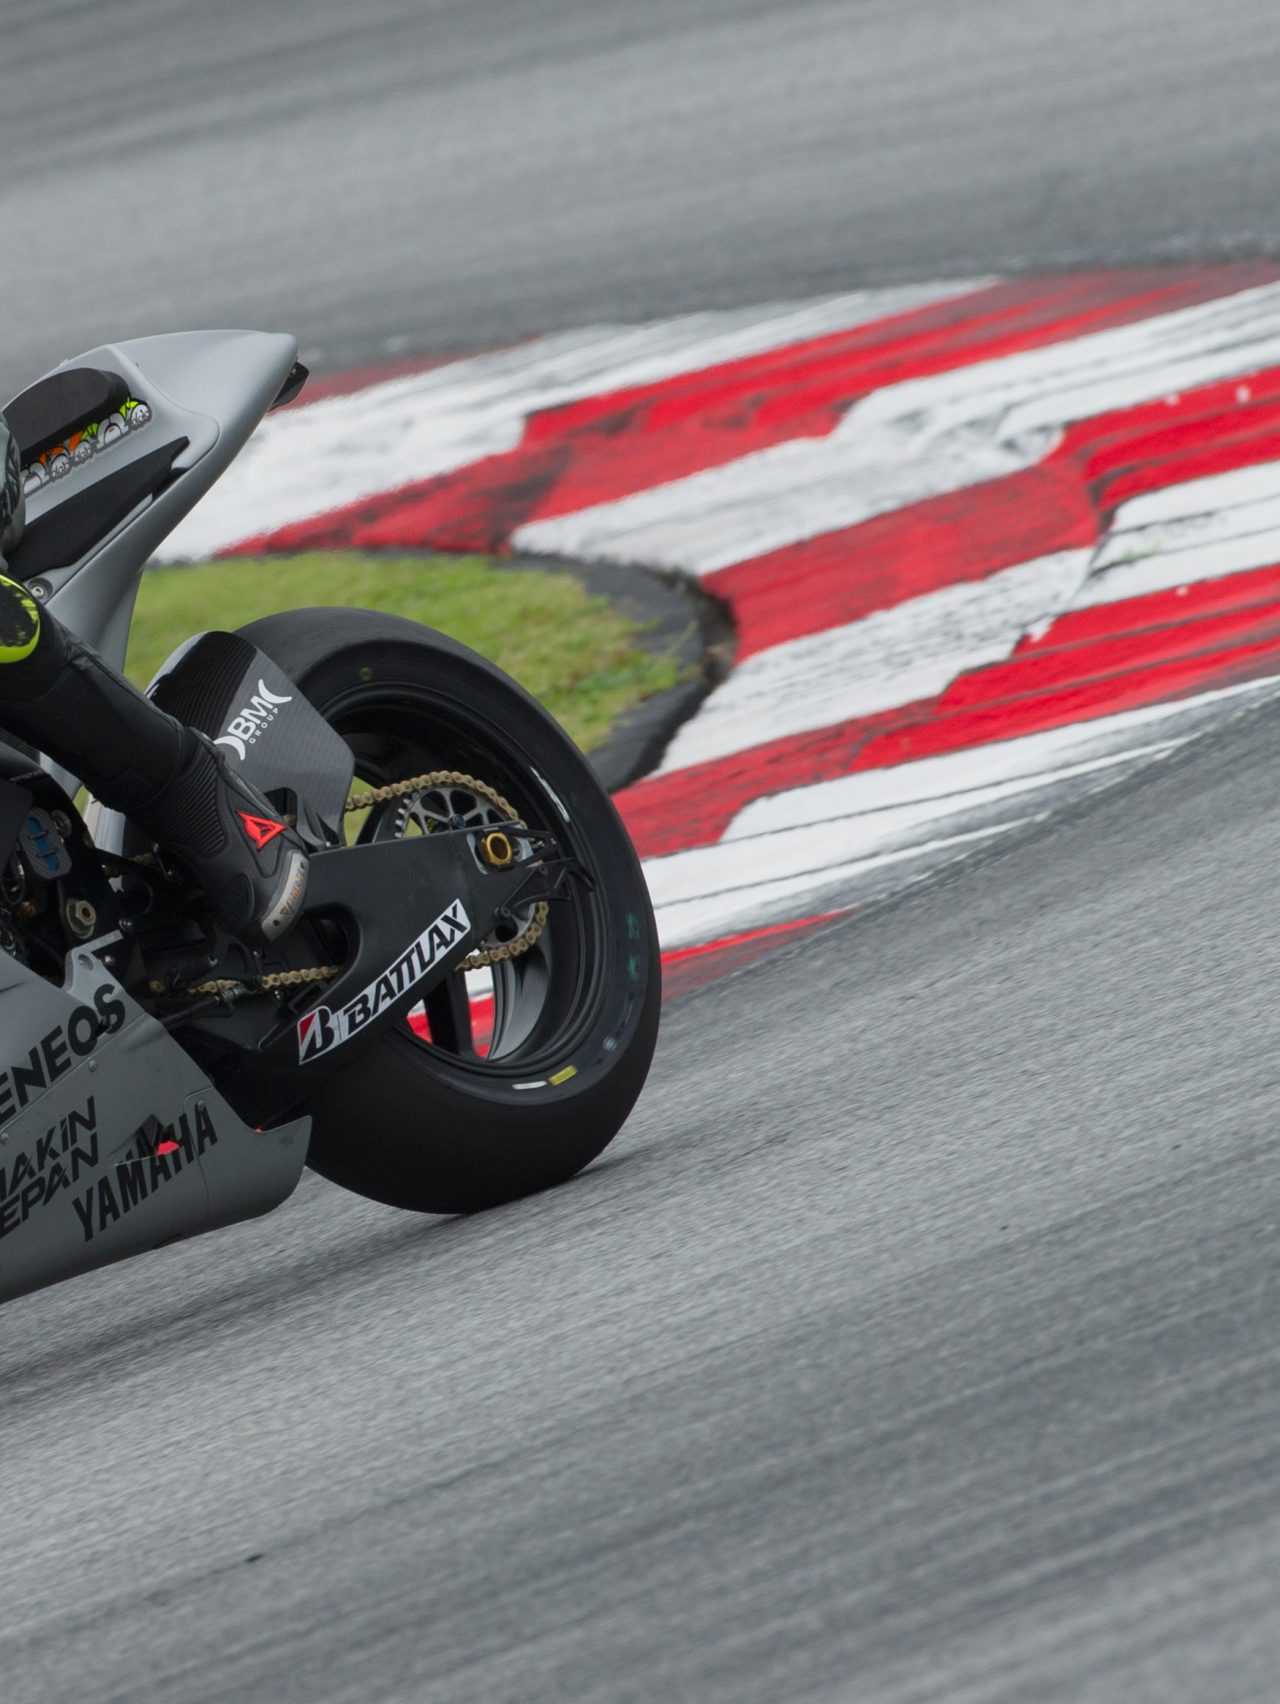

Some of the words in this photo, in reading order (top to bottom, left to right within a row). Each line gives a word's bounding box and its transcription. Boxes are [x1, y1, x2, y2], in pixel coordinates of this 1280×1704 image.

[249, 706, 279, 744] GROUP
[343, 903, 468, 1032] BATTLAX
[72, 1103, 218, 1243] YAMAHA
